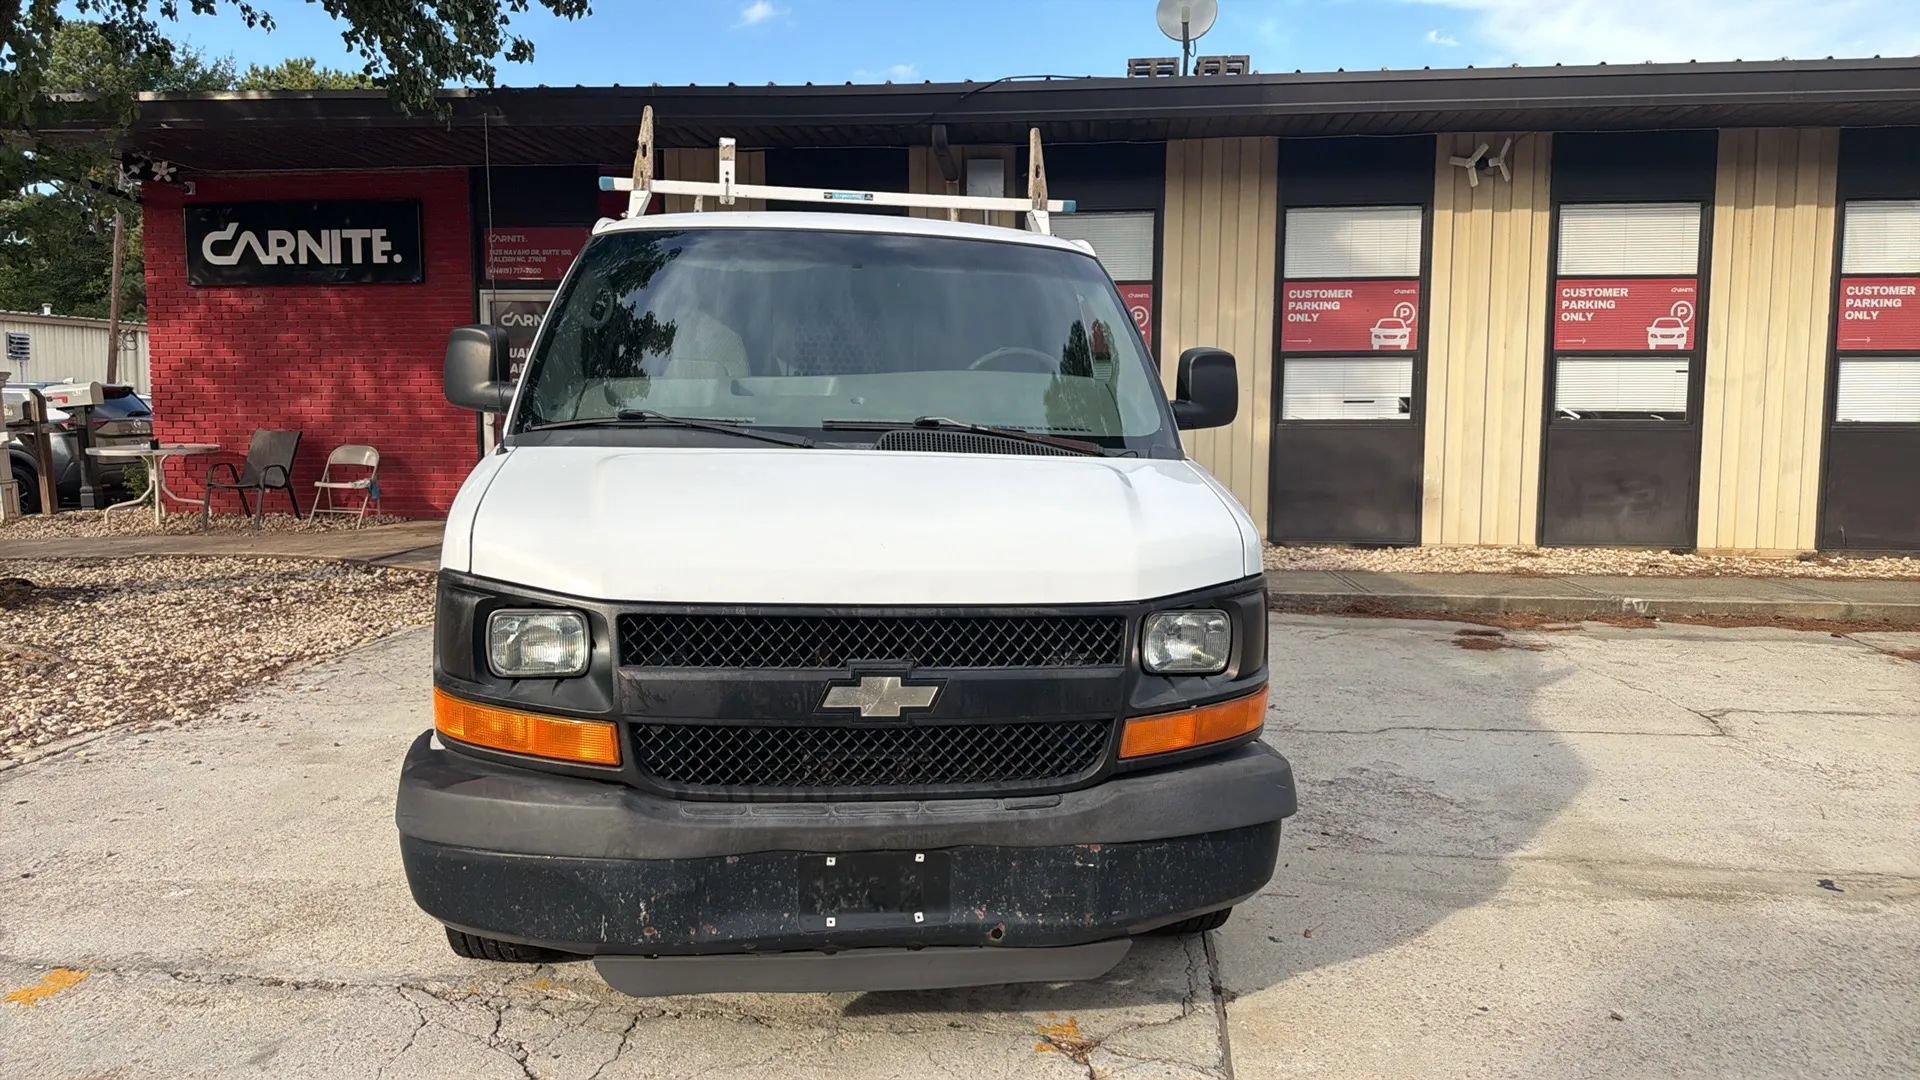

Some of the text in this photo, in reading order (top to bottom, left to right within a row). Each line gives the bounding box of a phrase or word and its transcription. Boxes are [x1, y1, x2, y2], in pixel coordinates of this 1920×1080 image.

[1288, 289, 1353, 299] CUSTOMER
[1562, 288, 1629, 297] CUSTOMER
[1846, 286, 1917, 296] CUSTOMER
[1288, 301, 1341, 311] PARKING
[1561, 300, 1616, 309] PARKING
[1845, 298, 1903, 308] PARKING
[1287, 313, 1320, 322] ONLY
[1561, 312, 1595, 321] ONLY
[1844, 310, 1880, 320] ONLY
